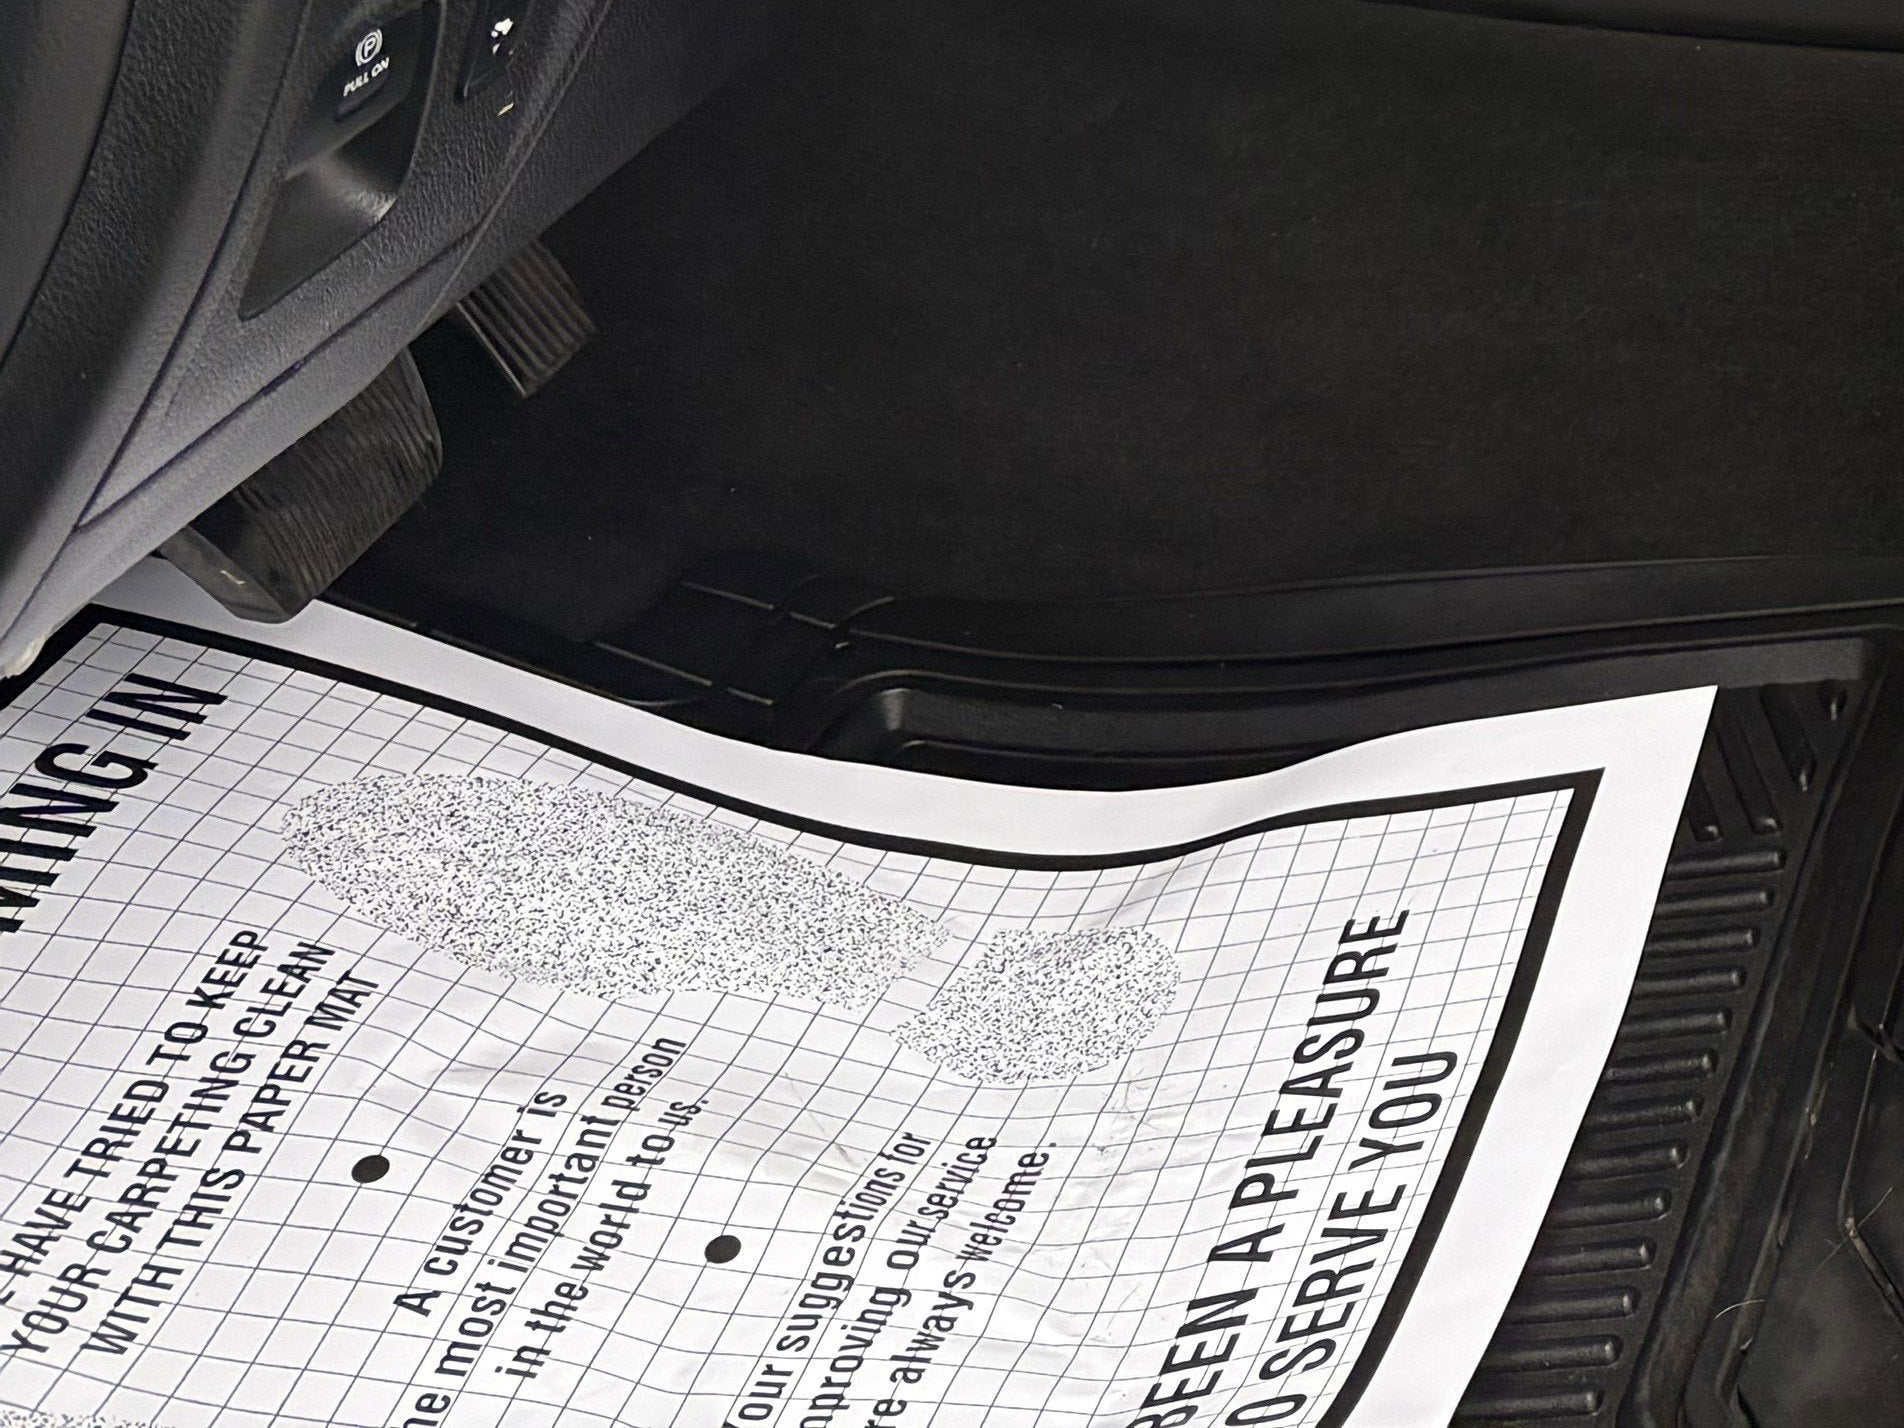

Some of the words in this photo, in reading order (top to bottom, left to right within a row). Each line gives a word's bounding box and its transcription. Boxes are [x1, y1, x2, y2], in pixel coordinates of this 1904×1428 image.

[372, 57, 389, 77] ON
[86, 673, 228, 741] IN
[0, 1187, 90, 1278] HAVE
[63, 1078, 170, 1179] TRIED
[145, 1020, 209, 1067] TO
[185, 929, 269, 1010] KEEP
[2, 1263, 111, 1354] YOUR
[85, 1050, 257, 1254] CARPETING
[232, 941, 336, 1038] CLEAN
[79, 1262, 185, 1356] WITH
[155, 1166, 246, 1249] THIS
[221, 1038, 331, 1154] PAPER
[303, 969, 379, 1032] MAT
[393, 1289, 442, 1317] A
[423, 1128, 543, 1276] customer
[516, 1091, 568, 1118] is
[887, 1220, 936, 1270] our
[918, 1137, 997, 1220] service
[1228, 909, 1410, 1211] PLEASURE
[434, 1282, 517, 1376] most
[487, 1115, 621, 1273] important
[600, 1037, 688, 1111] person
[495, 1344, 553, 1380] in
[524, 1281, 590, 1334] the
[571, 1179, 653, 1271] world
[626, 1132, 676, 1167] to
[658, 1098, 710, 1126] us.
[722, 1363, 795, 1428] our
[776, 1167, 906, 1352] suggestions
[878, 1132, 932, 1165] for
[890, 1270, 977, 1384] always
[956, 1142, 1057, 1262] welcome.
[1207, 1222, 1286, 1263] A
[1259, 1183, 1408, 1381] SERVE
[1347, 1050, 1459, 1173] YOU
